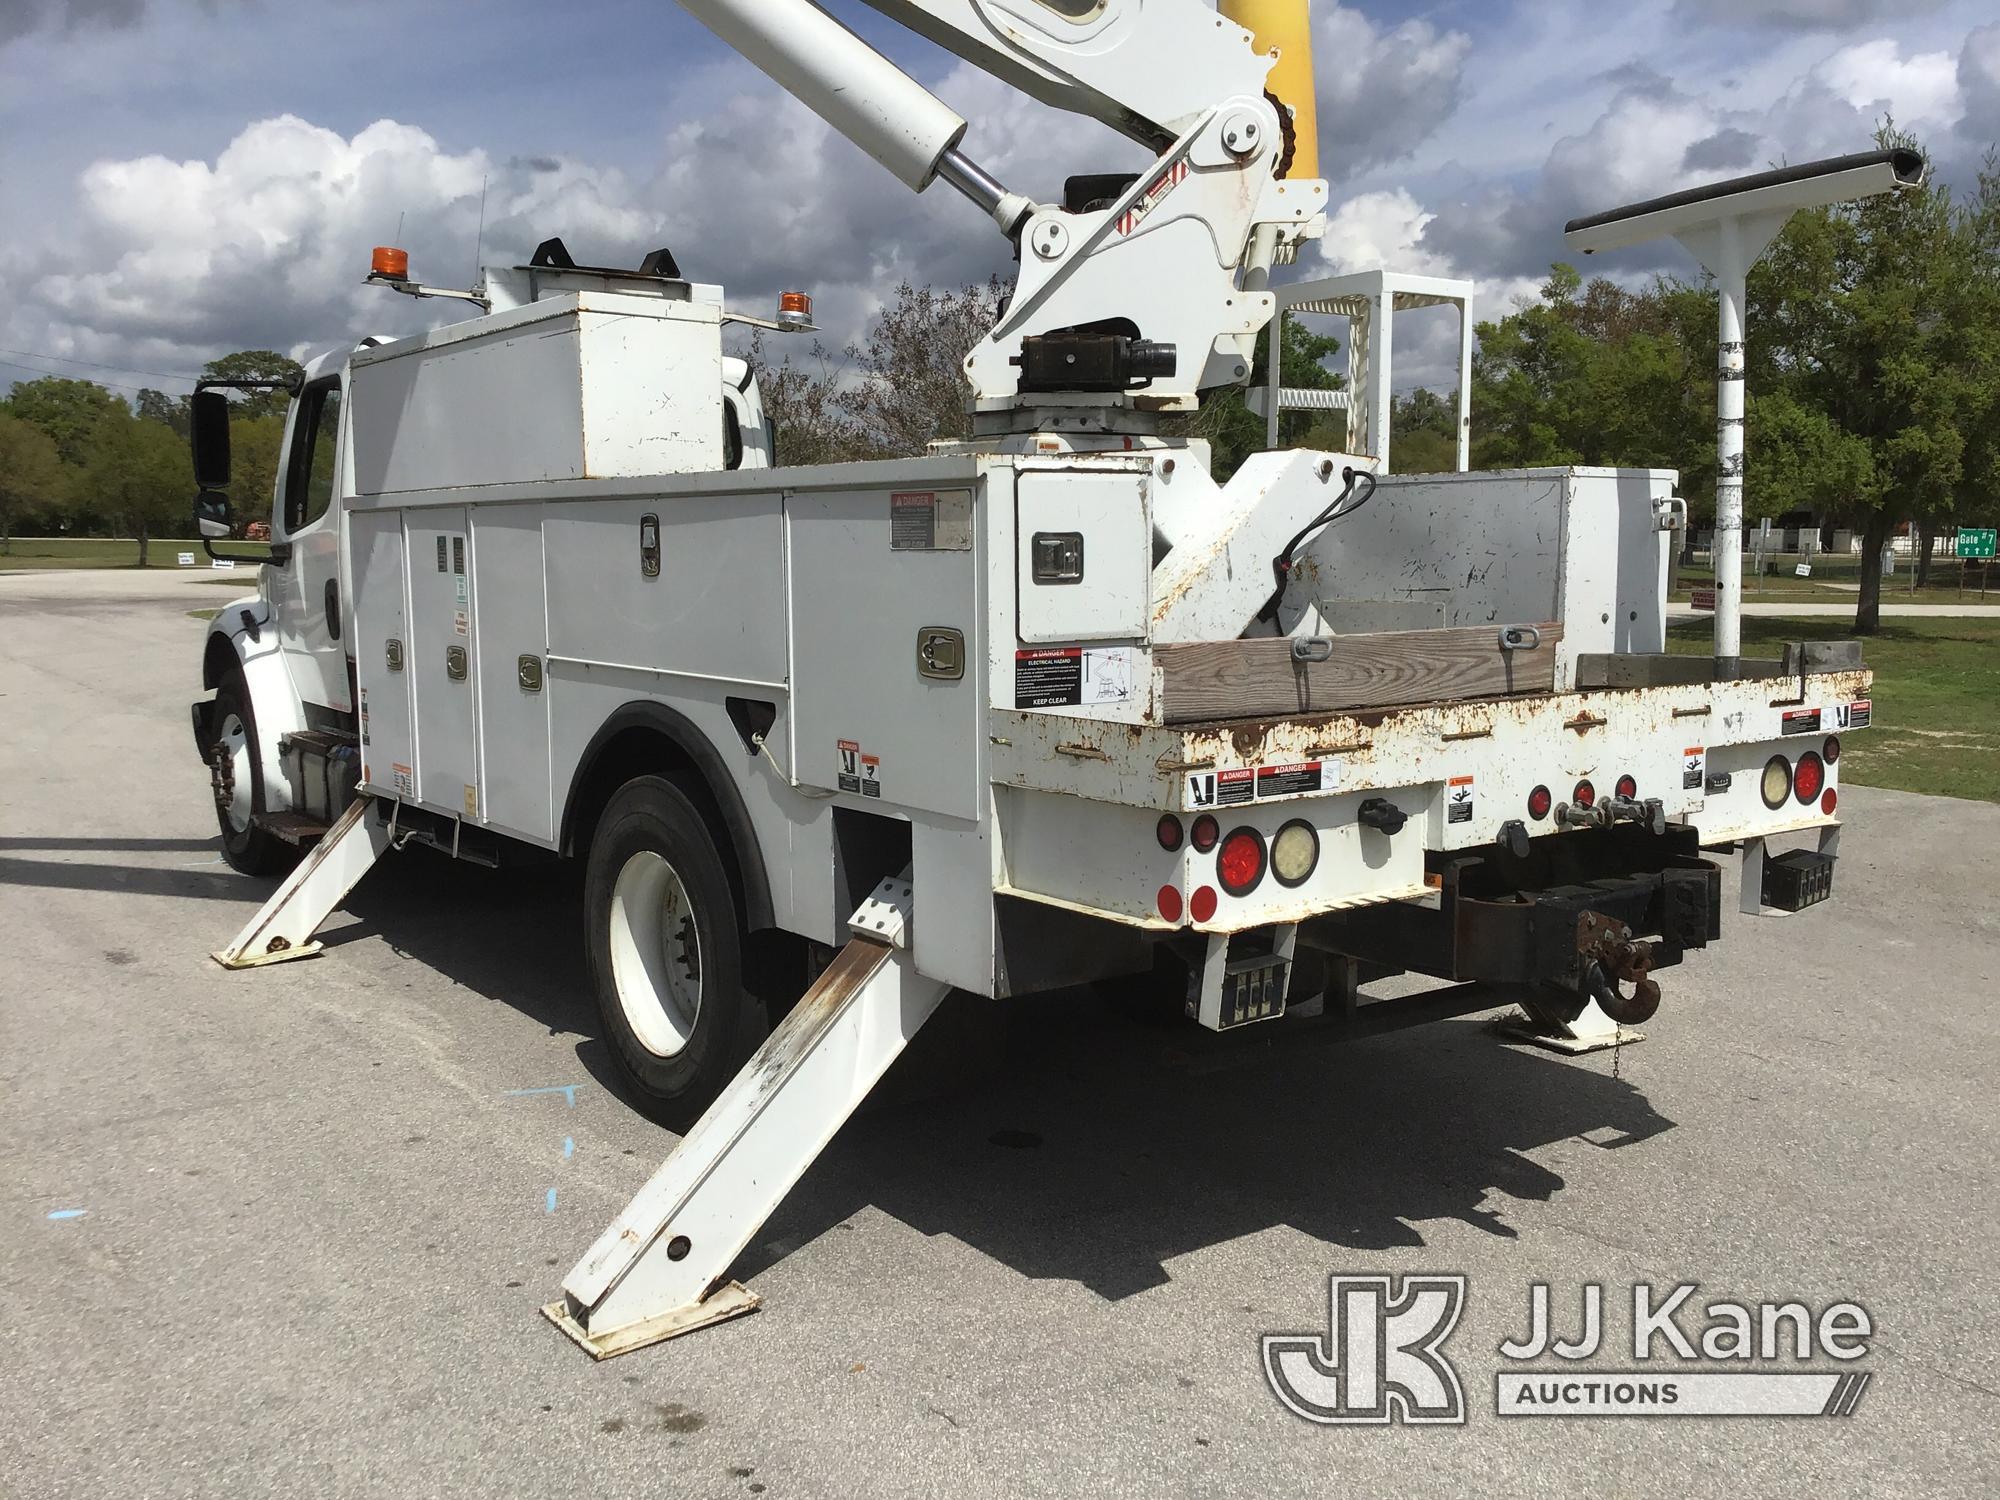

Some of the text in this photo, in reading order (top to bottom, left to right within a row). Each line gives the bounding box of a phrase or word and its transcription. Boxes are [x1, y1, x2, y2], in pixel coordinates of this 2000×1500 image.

[903, 496, 929, 506] DANGER
[1960, 534, 1978, 544] Gate
[1279, 764, 1307, 774] DANGER
[1228, 770, 1250, 779] DANGER
